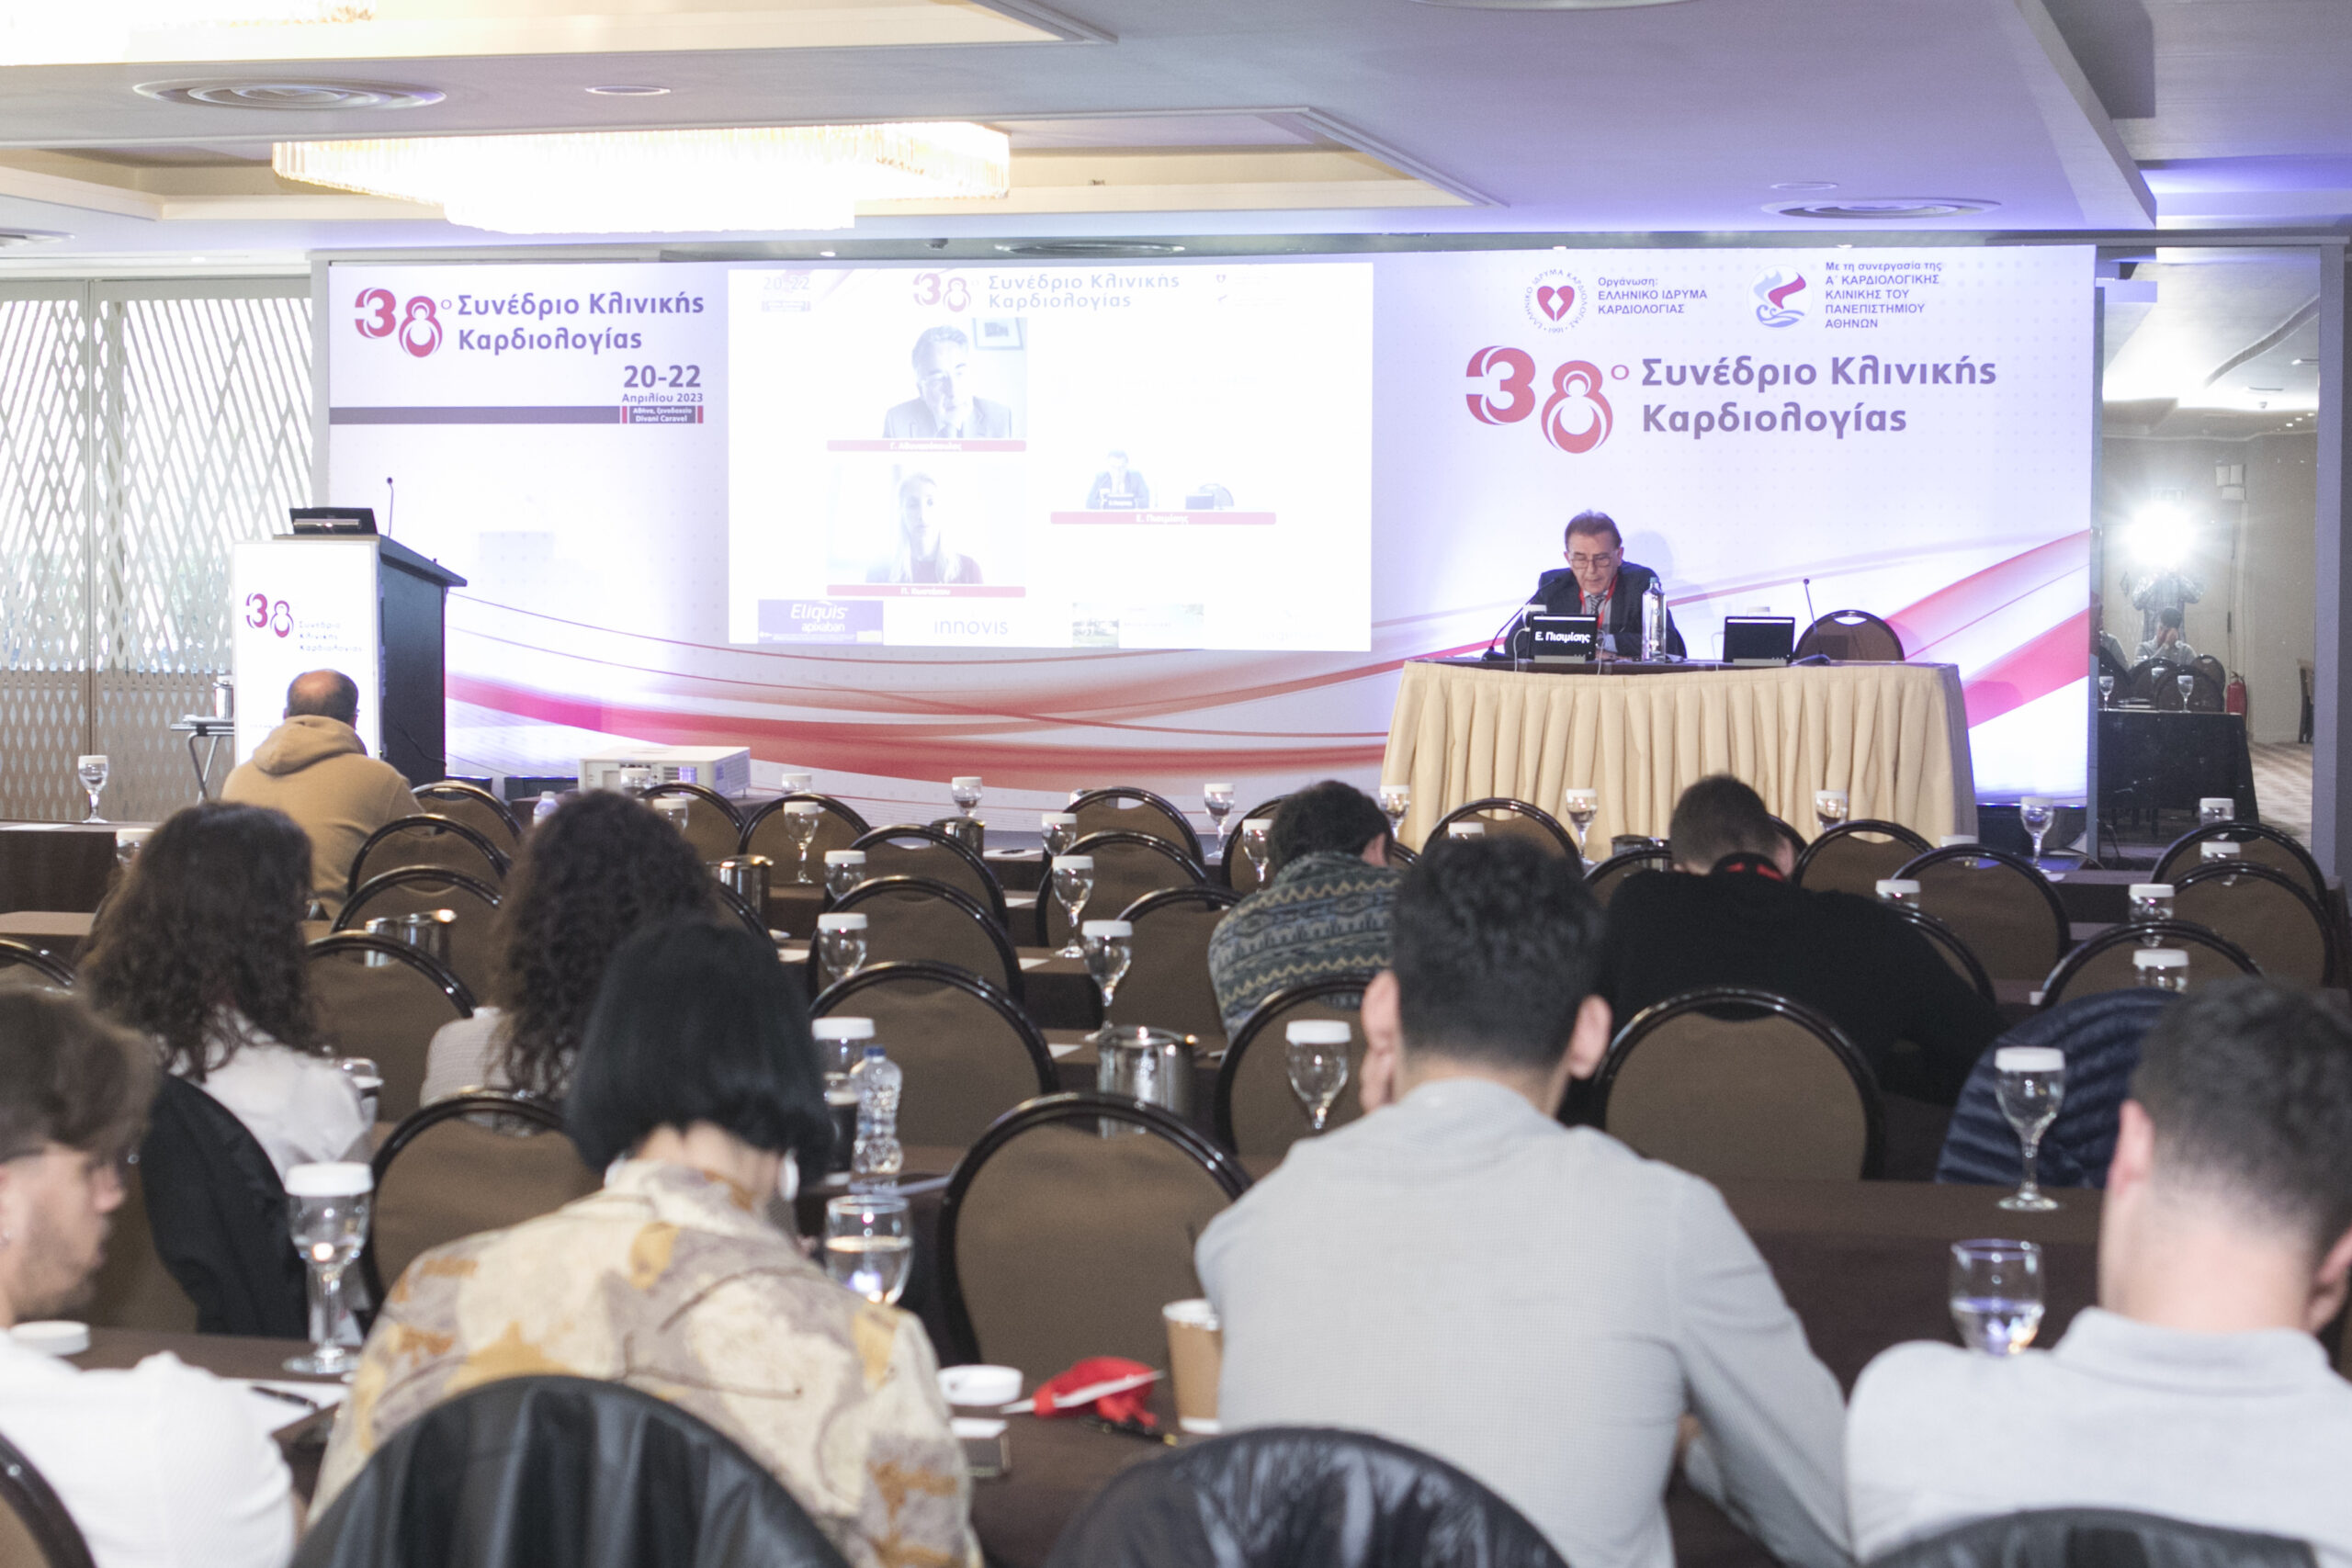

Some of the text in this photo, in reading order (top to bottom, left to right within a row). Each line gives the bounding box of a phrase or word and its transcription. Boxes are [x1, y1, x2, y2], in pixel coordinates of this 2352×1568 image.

[1826, 261, 1942, 273] Με τη συνεργασία της
[989, 274, 1180, 292] Συνέδριο Κλινικής
[1598, 276, 1658, 288] Οργάνωση:
[1841, 275, 1940, 285] ΚΑΡΔΙΟΛΟΓΙΚΗΣ
[1598, 289, 1708, 300] ΕΛΛΗΝΙΚΟ ΙΔΡΥΜΑ
[1826, 289, 1909, 299] ΚΛΙΝΙΚΗΣ ΤΟΥ
[458, 291, 704, 321] Συνέδριο Κλινικής
[989, 293, 1132, 310] Καρδιολογίας
[1598, 304, 1685, 314] ΚΑΡΔΙΟΛΟΓΙΑΣ
[1826, 304, 1925, 313] ΠΑΝΕΠΙΣΤΗΜΙΟΥ
[1825, 319, 1878, 328] ΑΘΗΝΩΝ
[459, 328, 642, 355] Καρδιολογίας
[624, 365, 701, 388] 20-22
[1642, 355, 1996, 393] Συνέδριο Κλινικής
[622, 393, 703, 404] Απριλίου 2023
[1643, 401, 1907, 439] Καρδιολογίας
[790, 602, 849, 621] Eliquis
[801, 621, 845, 633] apixaban
